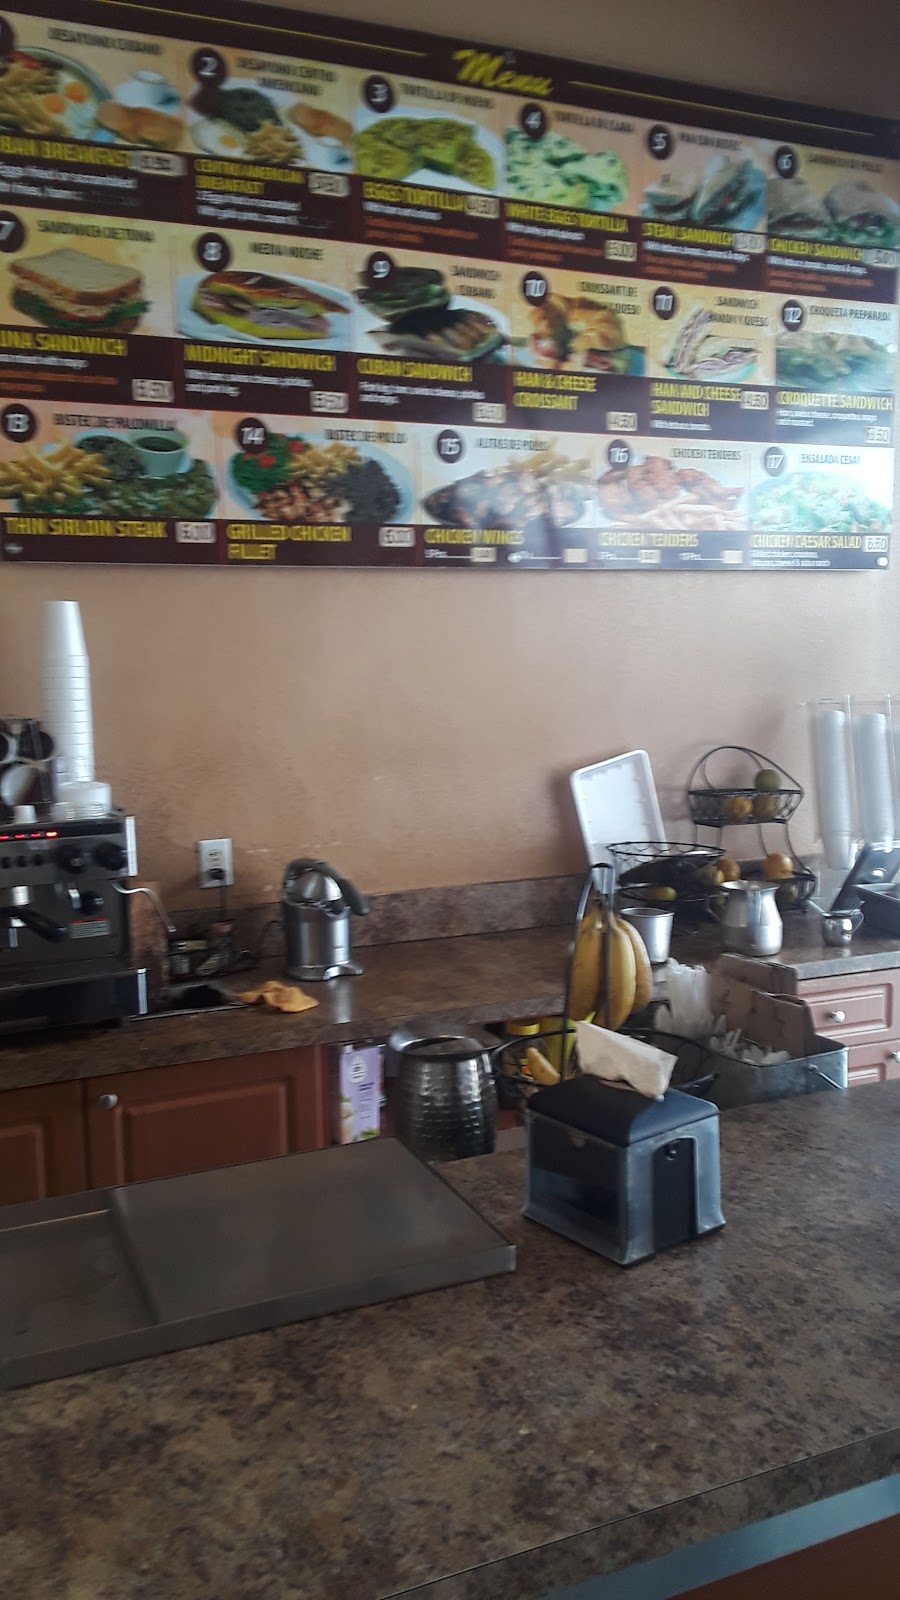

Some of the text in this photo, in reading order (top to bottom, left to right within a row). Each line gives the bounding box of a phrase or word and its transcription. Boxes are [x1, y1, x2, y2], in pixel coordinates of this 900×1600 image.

[199, 55, 218, 76] 2
[453, 49, 554, 96] Menu
[370, 83, 388, 102] 3
[526, 111, 542, 129] 4
[650, 132, 667, 150] 5
[777, 153, 792, 170] 6
[0, 220, 16, 241] 7
[643, 222, 733, 247] STEAK SANDWICH
[202, 241, 222, 262] 8
[770, 238, 811, 255] CHICKEN
[814, 243, 863, 262] SANDWICH
[372, 260, 391, 279] 9
[524, 278, 547, 297] 10
[655, 294, 674, 311] 11
[715, 295, 758, 310] SANDWICH
[745, 316, 770, 327] QUESO
[783, 306, 802, 323] 12
[809, 304, 892, 321] CROQUETA PREPARADA
[34, 332, 128, 357] SANDWICH
[183, 344, 336, 372] MIDNIGHT SANDWICH
[356, 357, 473, 383] CUBAN SANDWICH
[556, 375, 597, 392] CHEESE
[651, 382, 742, 402] HAM AND CHEESE
[651, 400, 710, 417] SANDWICH
[777, 391, 894, 412] CROQUETTE SANDWICH
[240, 426, 266, 446] 14
[439, 437, 463, 455] 15
[610, 446, 630, 463] 16
[672, 446, 742, 461] CHICKEN TENDERS
[766, 453, 785, 470] 17
[800, 452, 838, 465] ENSALADA
[3, 516, 168, 538] THIN SIRLOIN STEAK
[424, 528, 480, 545] CHICKEN
[599, 531, 699, 548] CHICKEN TENDERS
[749, 534, 862, 550] CHICKEN CAESAR SALAD
